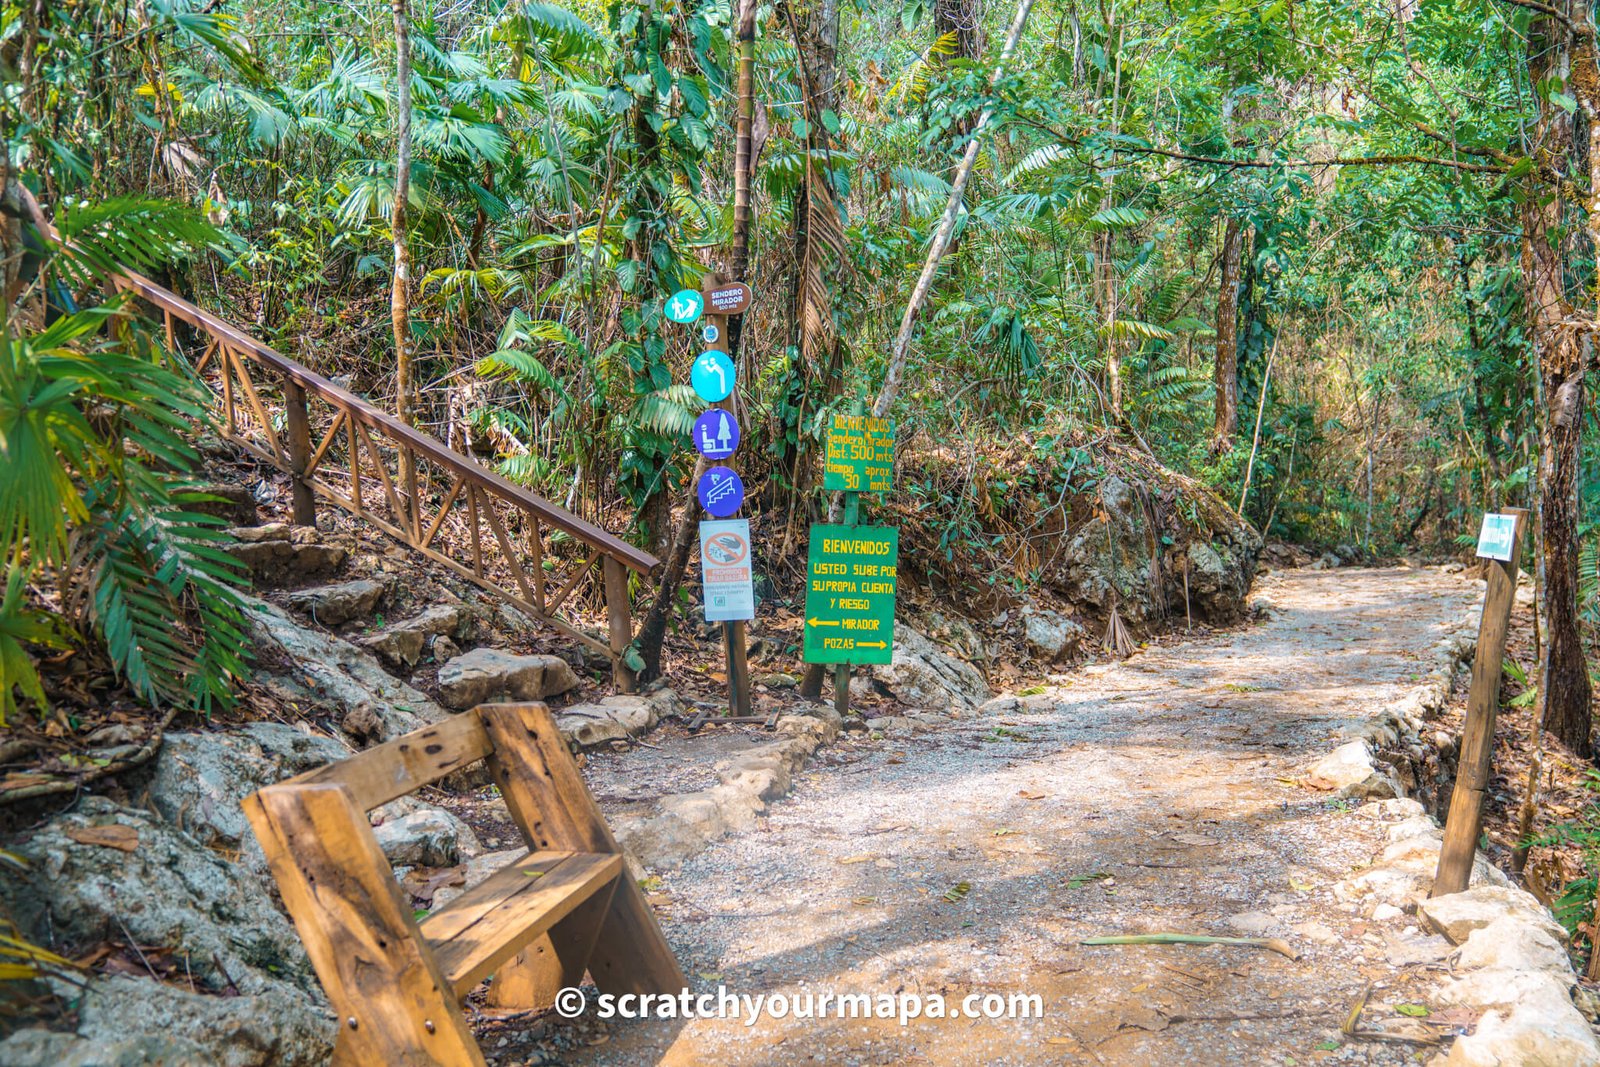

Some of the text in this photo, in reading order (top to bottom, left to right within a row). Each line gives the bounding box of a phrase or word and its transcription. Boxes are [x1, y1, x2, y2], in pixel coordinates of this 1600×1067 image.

[711, 288, 743, 299] SENDERO
[712, 296, 743, 305] MIRADOR
[835, 414, 890, 433] BIENVENIDOS
[827, 428, 863, 445] Sendero
[850, 445, 875, 460] 500
[876, 447, 893, 462] mts
[826, 456, 854, 479] tiempo
[845, 473, 891, 491] 30 mnts
[823, 539, 890, 555] BIENVENIDOS
[813, 563, 897, 577] USTED SUBE POR
[861, 582, 894, 594] CUENTA
[830, 598, 870, 610] Y RIESGO
[842, 618, 880, 631] MIRADOR
[824, 638, 854, 649] POZAS
